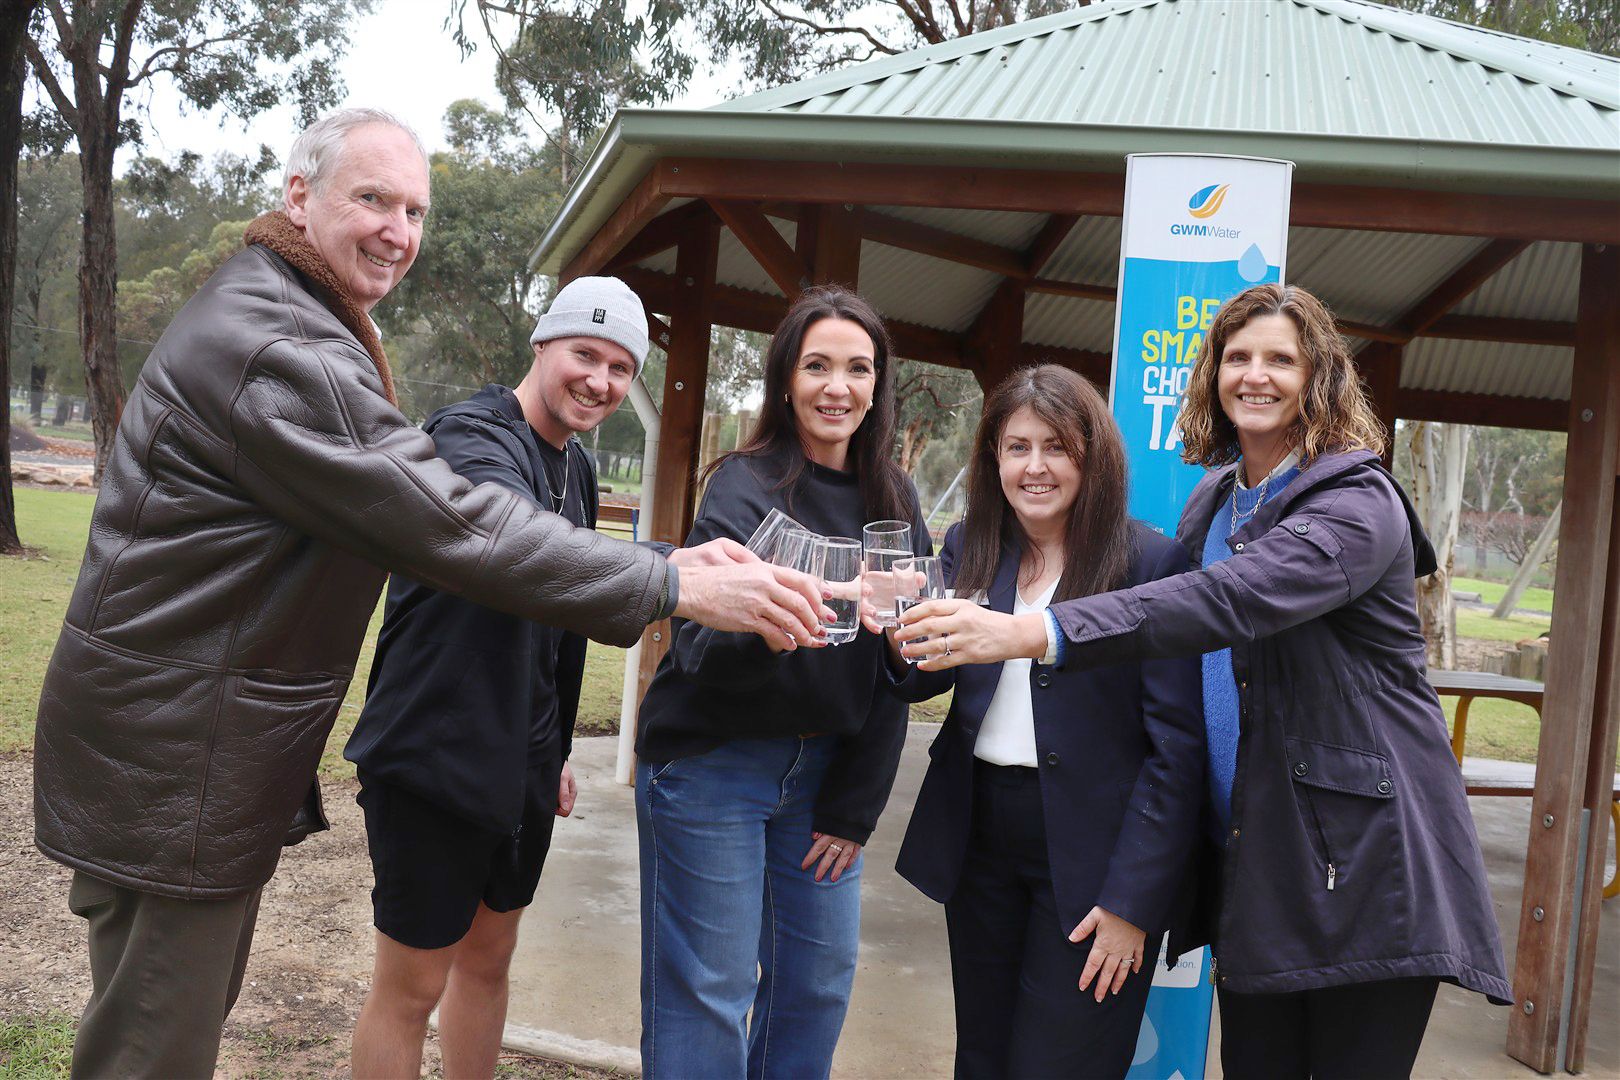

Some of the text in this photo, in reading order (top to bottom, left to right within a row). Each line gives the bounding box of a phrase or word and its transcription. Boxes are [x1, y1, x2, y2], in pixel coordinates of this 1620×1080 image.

[1170, 224, 1241, 239] GWMWater
[1177, 295, 1220, 331] BE
[1142, 330, 1202, 364] SMA
[1143, 366, 1193, 396] CHO
[1143, 395, 1188, 451] TA
